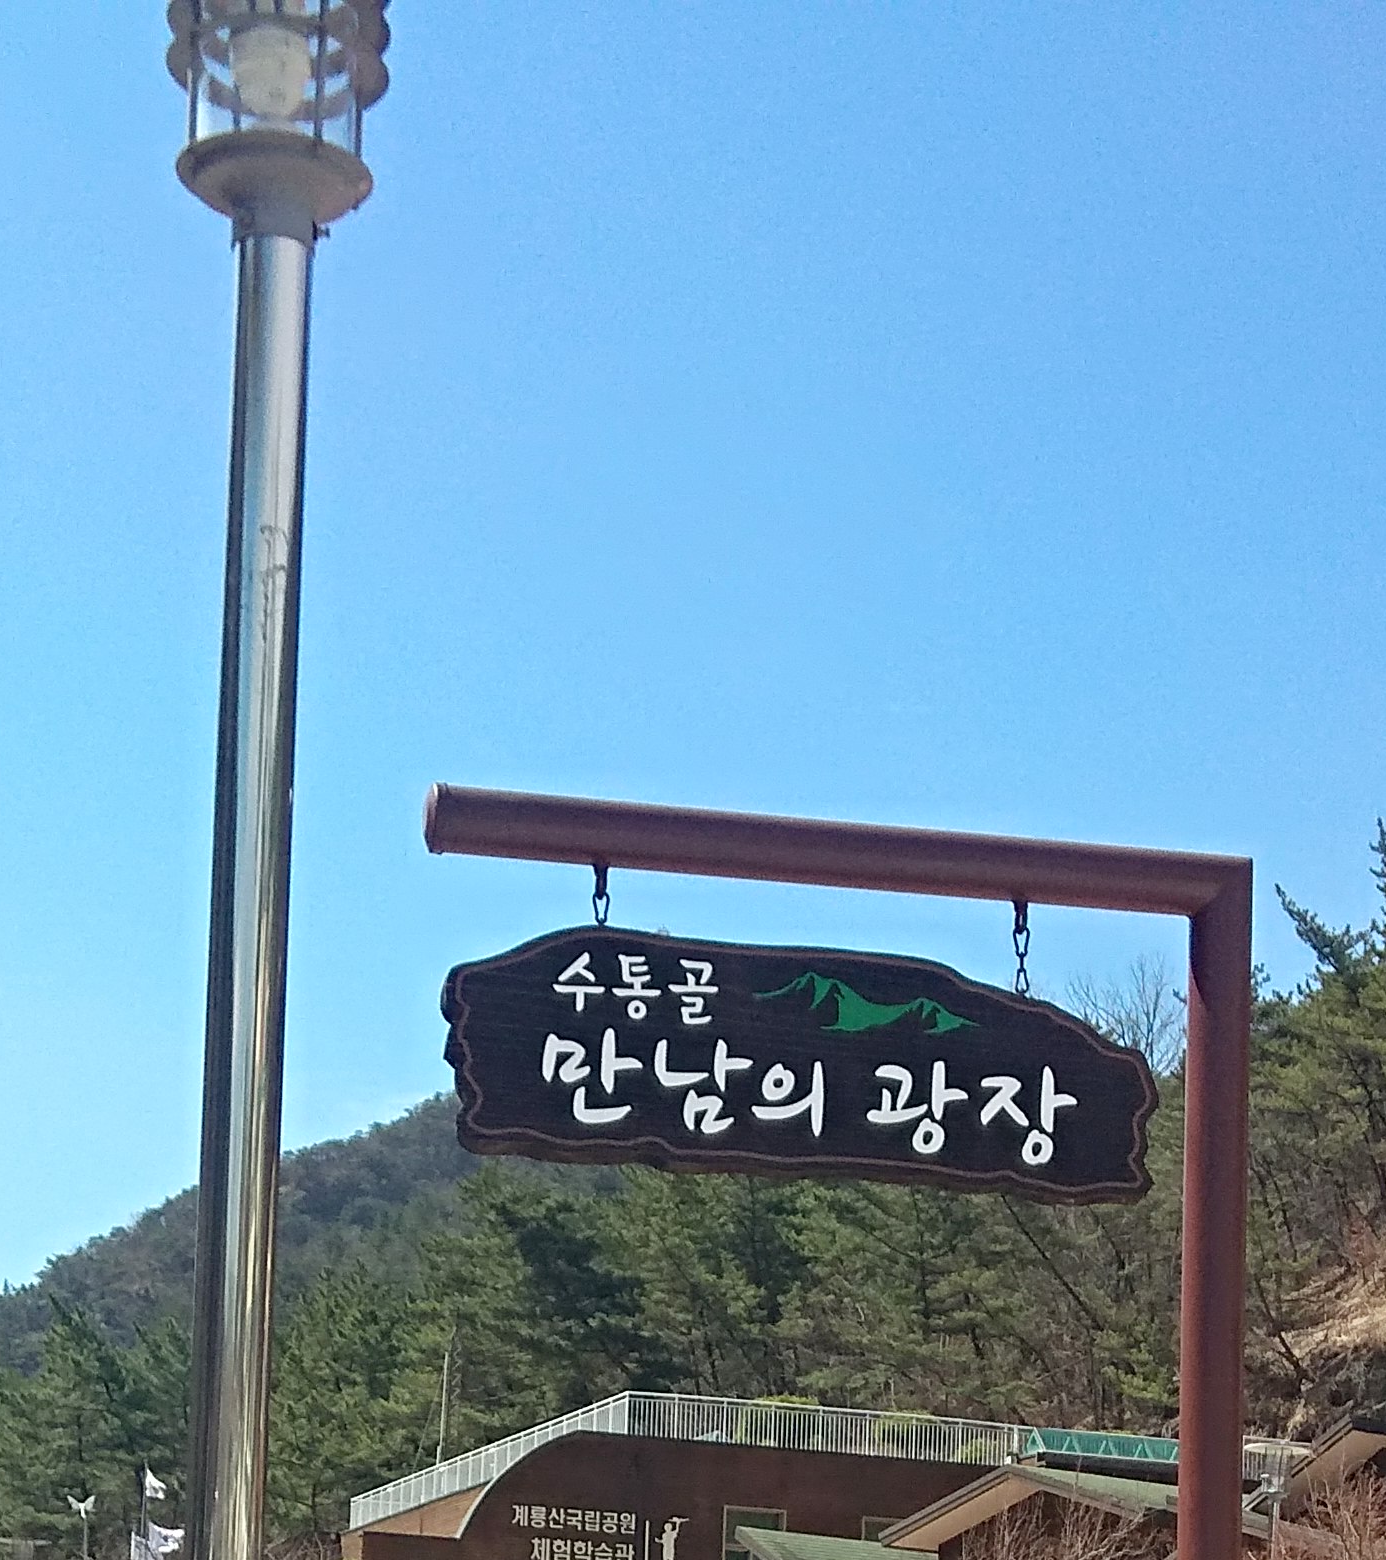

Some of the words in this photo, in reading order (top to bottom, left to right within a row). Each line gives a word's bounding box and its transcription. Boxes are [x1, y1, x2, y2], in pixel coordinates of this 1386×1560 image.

[551, 951, 720, 1025] 수통골
[541, 1028, 826, 1136] 만남의
[866, 1060, 1078, 1166] 광장
[511, 1504, 636, 1535] 계룡산국립공원
